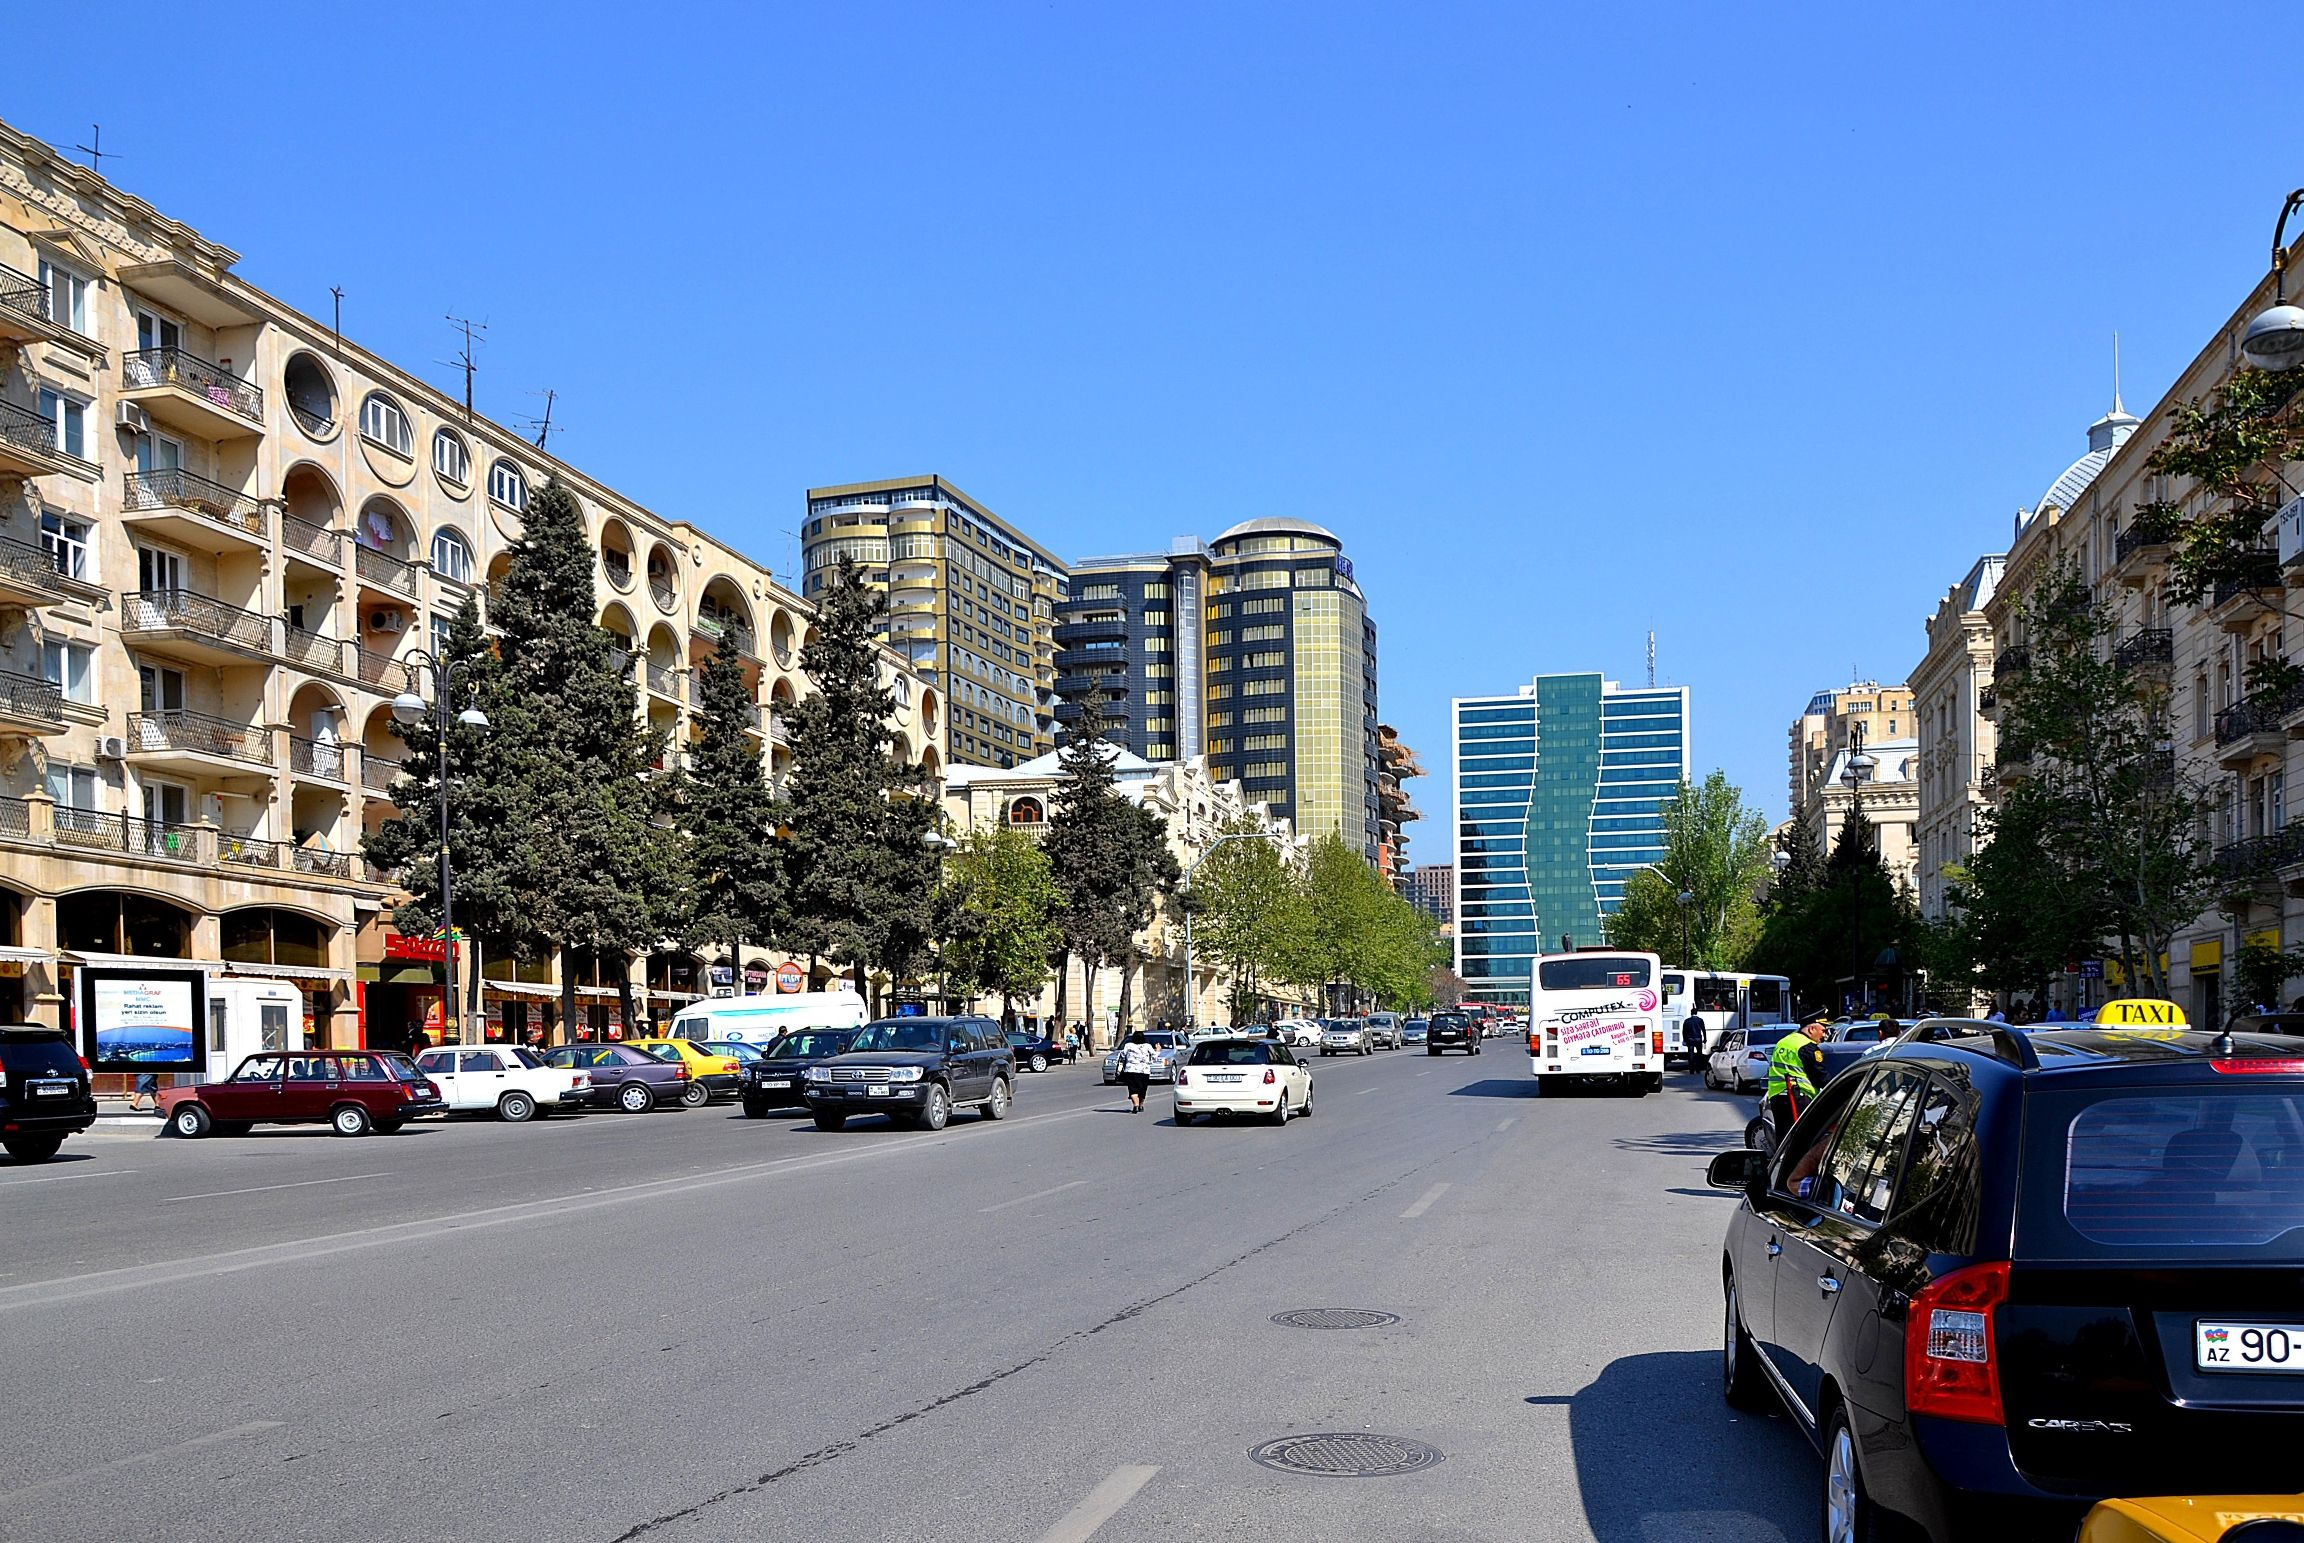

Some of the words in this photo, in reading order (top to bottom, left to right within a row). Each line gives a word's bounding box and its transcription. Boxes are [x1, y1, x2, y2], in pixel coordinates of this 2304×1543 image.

[1561, 1000, 1626, 1024] COMPUTEX
[2116, 1004, 2174, 1023] TAXI
[2207, 1347, 2231, 1362] AZ
[2027, 1418, 2132, 1433] CARENS
